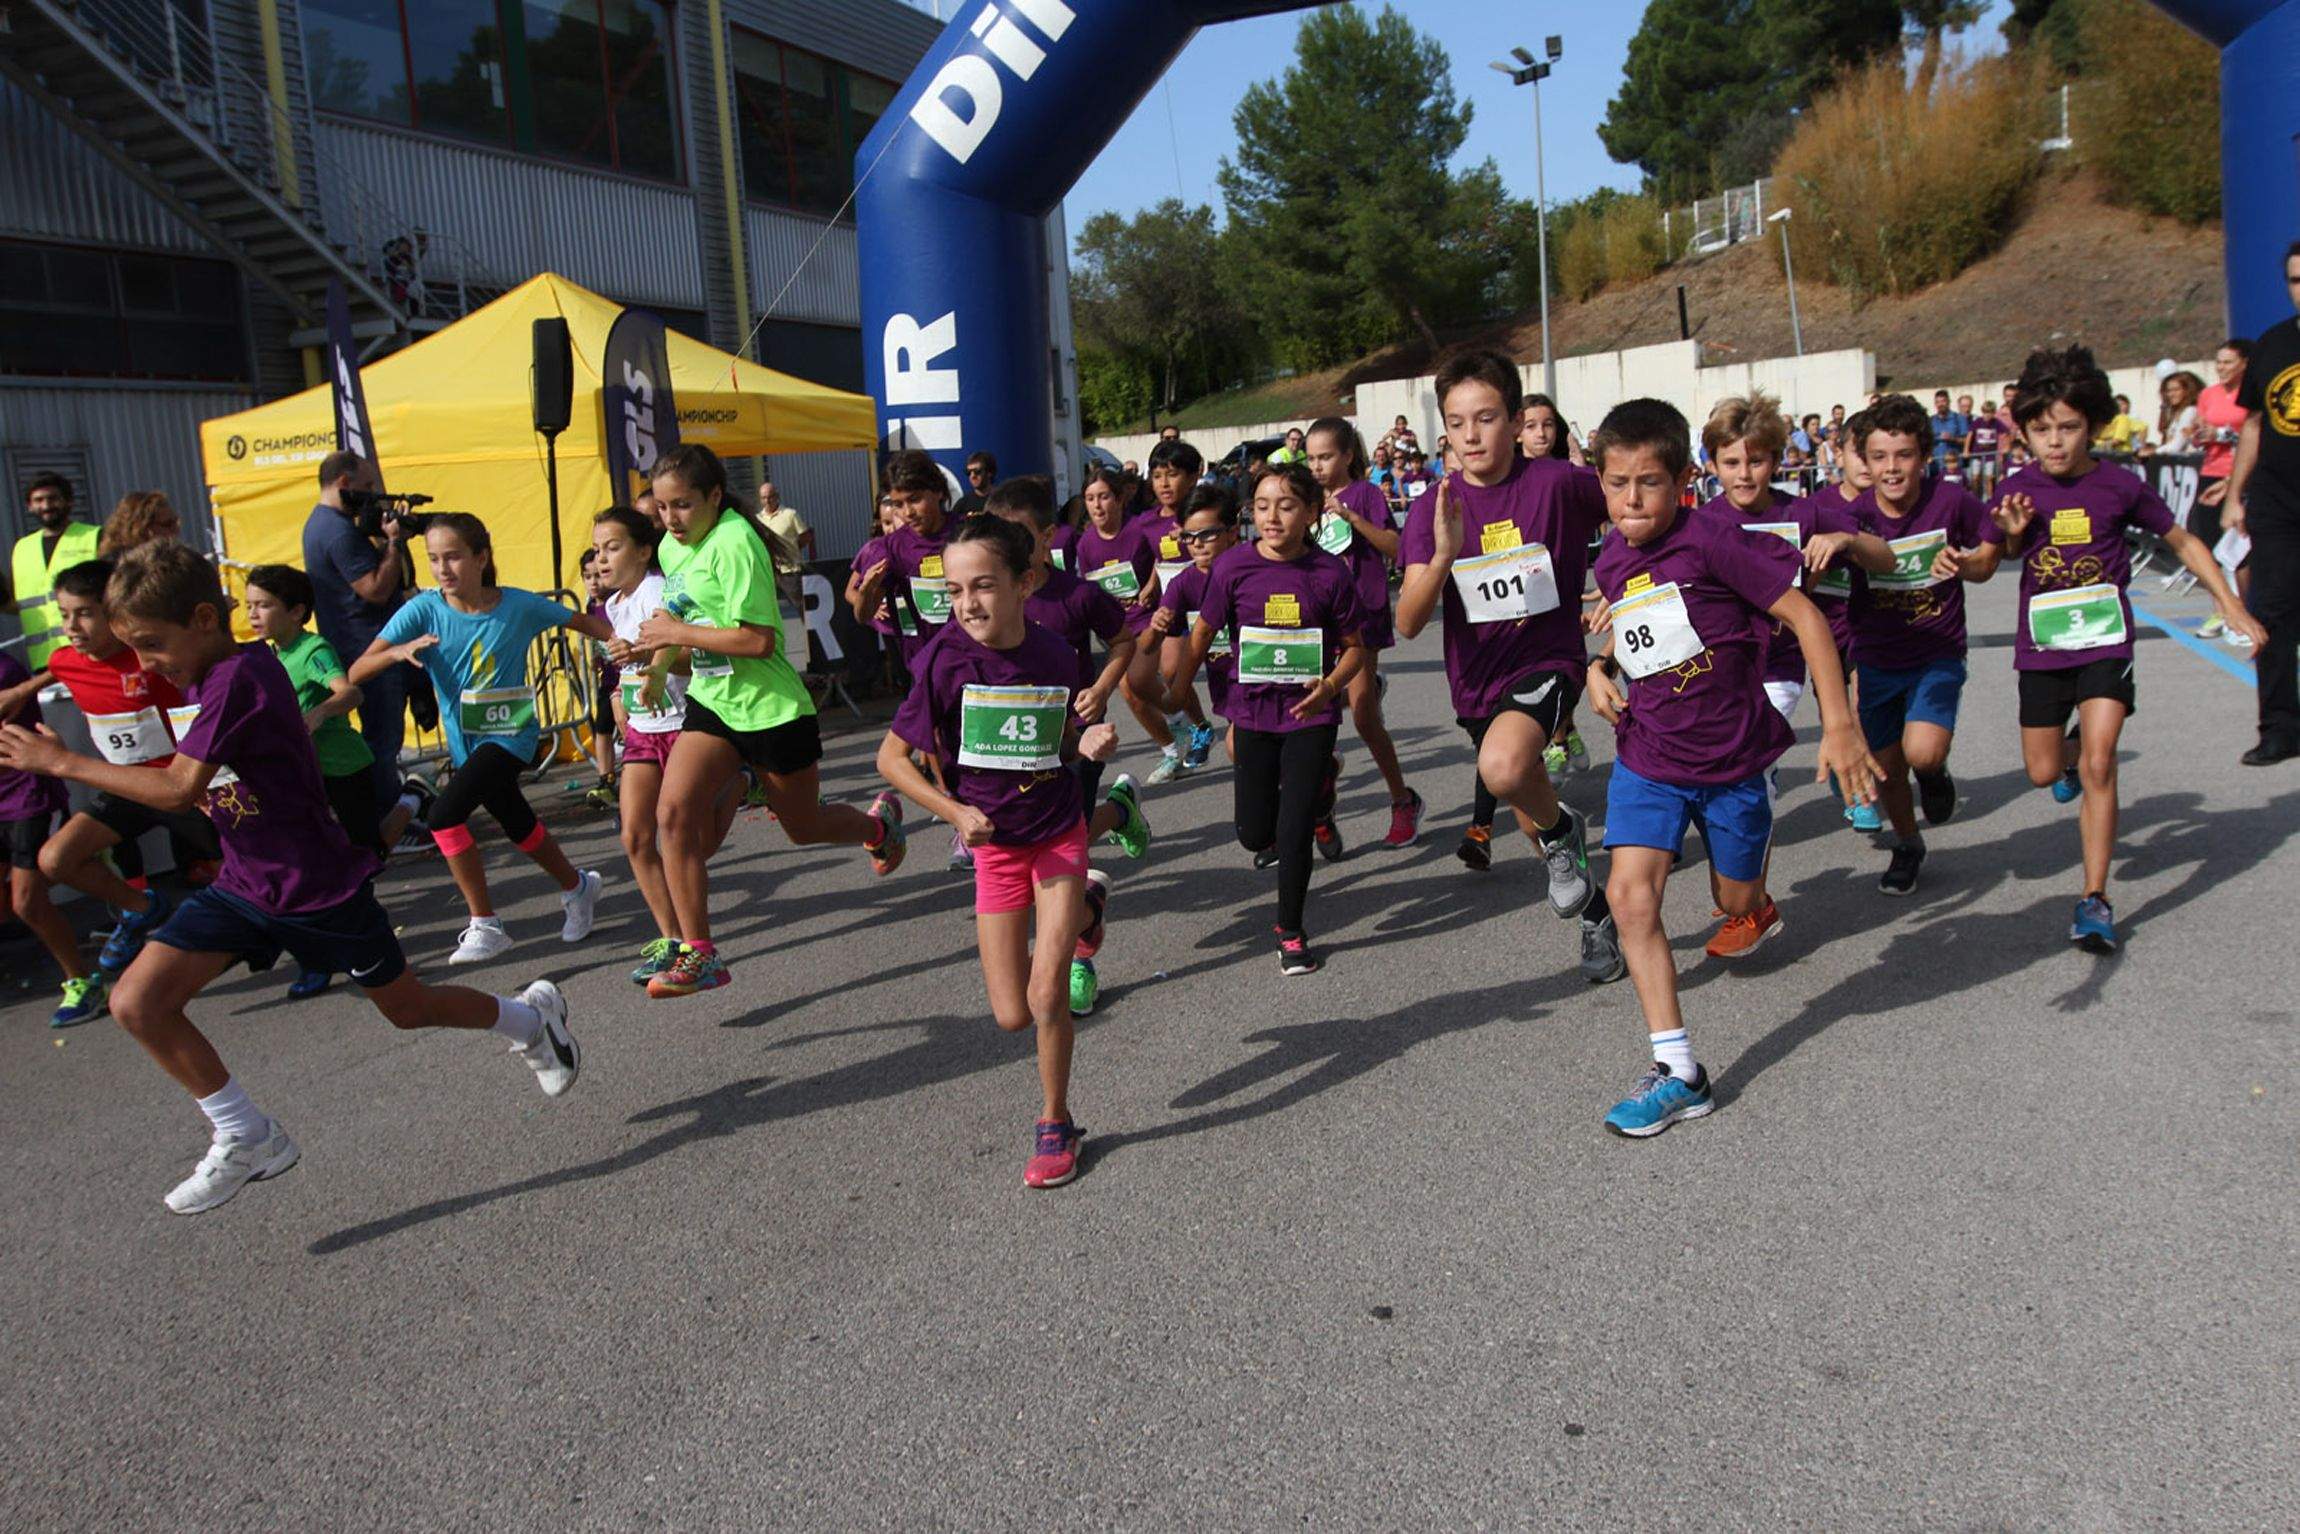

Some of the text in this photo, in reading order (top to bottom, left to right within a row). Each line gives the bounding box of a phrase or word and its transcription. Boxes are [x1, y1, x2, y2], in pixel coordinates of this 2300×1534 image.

[910, 0, 1077, 165] Di
[623, 359, 658, 472] GLS
[883, 310, 964, 512] iR
[1895, 555, 1922, 574] 24
[1104, 577, 1122, 590] 62
[1477, 575, 1525, 602] 101
[2068, 609, 2085, 631] 3
[1624, 624, 1655, 654] 98
[1273, 648, 1288, 666] 8
[486, 704, 511, 722] 60
[999, 715, 1037, 741] 43
[109, 732, 136, 750] 93
